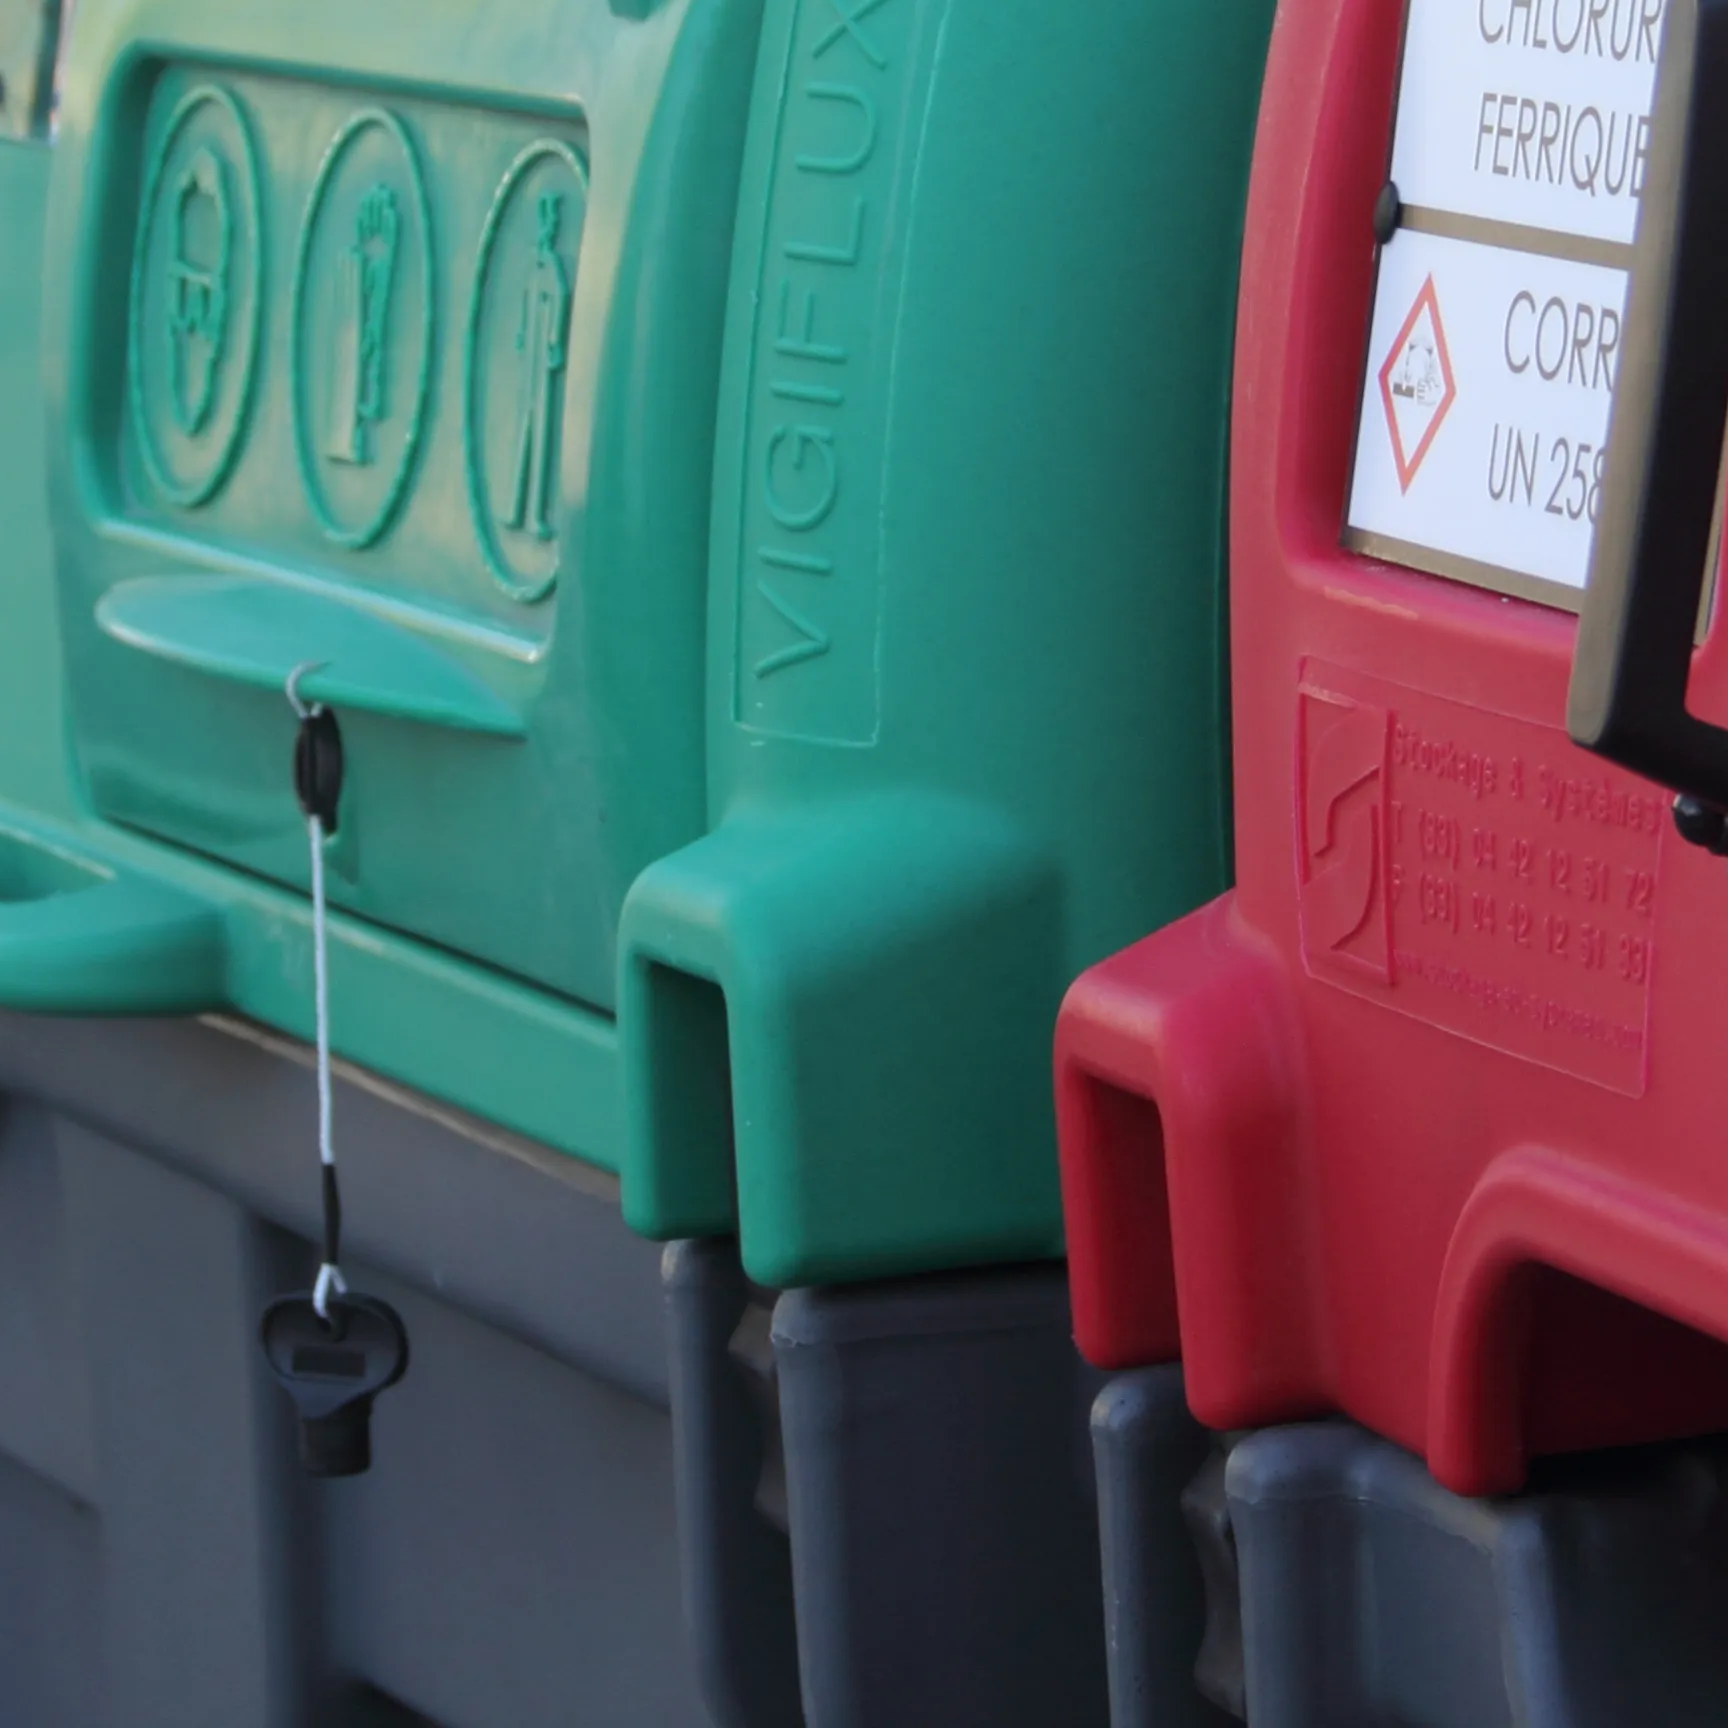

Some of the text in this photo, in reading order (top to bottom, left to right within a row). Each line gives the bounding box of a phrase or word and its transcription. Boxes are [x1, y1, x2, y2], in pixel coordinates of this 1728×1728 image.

[1474, 92, 1651, 198] FERRIQUE
[1504, 290, 1620, 392] CORR
[1488, 423, 1607, 524] UN 258
